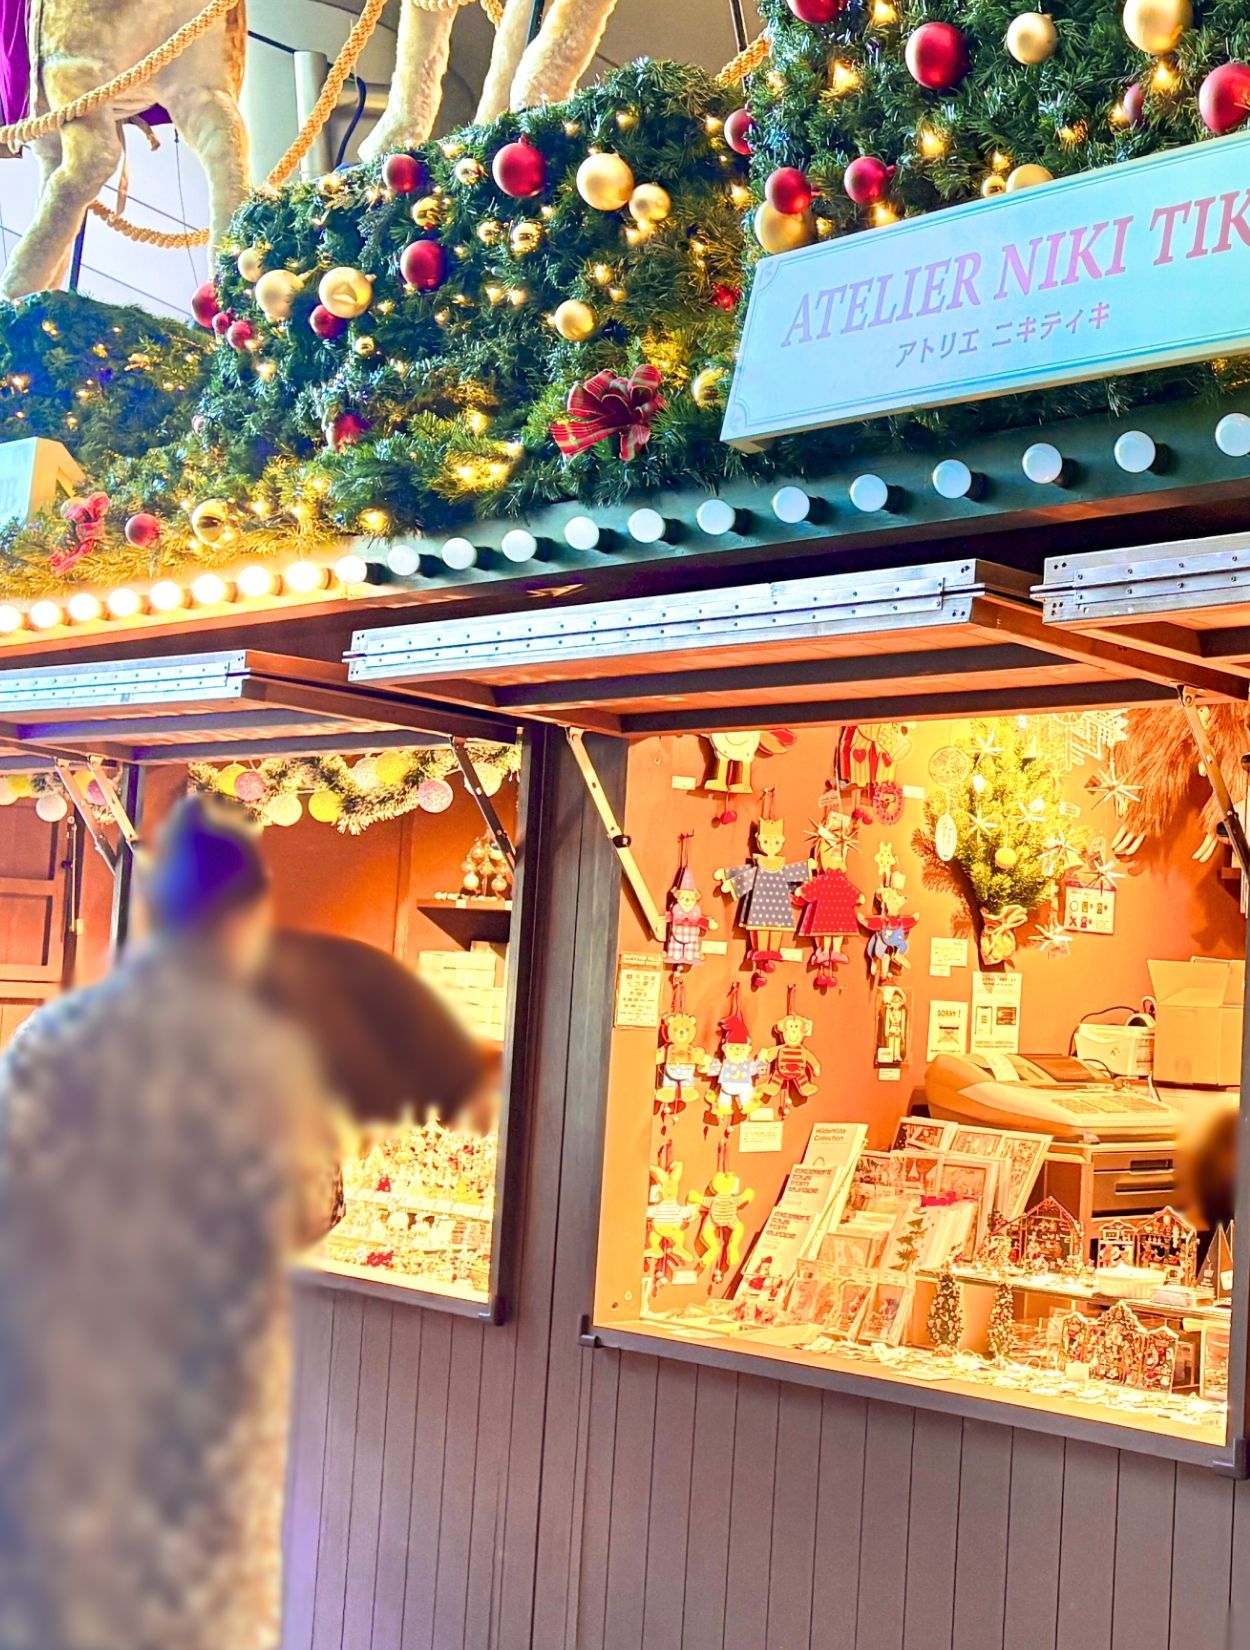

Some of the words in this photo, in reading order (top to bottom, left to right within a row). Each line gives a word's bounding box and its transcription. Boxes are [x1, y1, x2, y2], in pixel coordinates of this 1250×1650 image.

[781, 251, 982, 348] ATELIER
[993, 216, 1134, 300] NIKI
[895, 329, 980, 368] アトリエ
[992, 302, 1110, 347] ニキティキ
[937, 1009, 957, 1018] SORRY
